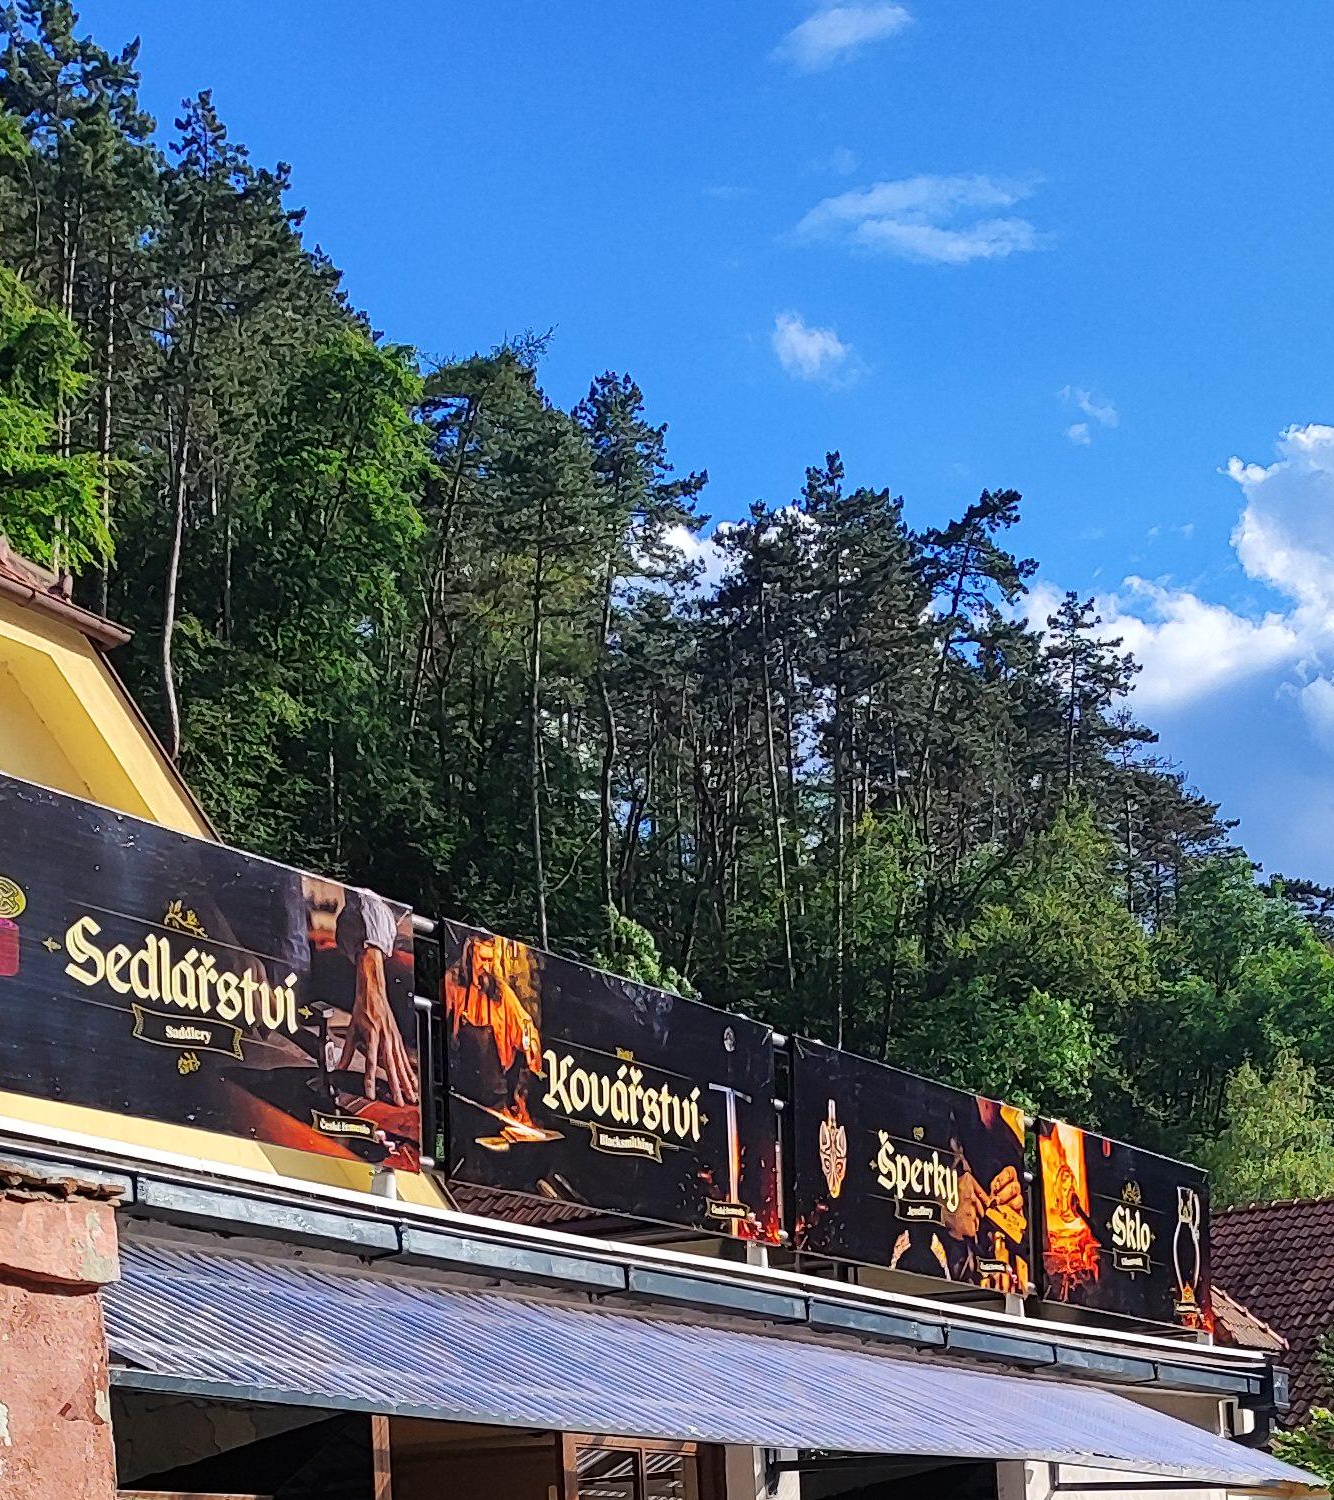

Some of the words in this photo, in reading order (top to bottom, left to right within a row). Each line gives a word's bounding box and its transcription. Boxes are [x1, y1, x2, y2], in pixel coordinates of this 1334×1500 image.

[65, 915, 298, 1034] Sedlářství
[165, 1025, 212, 1044] Saddlery
[542, 1050, 701, 1142] Kovářství
[877, 1129, 959, 1212] Šperky
[1112, 1205, 1151, 1252] Sklo
